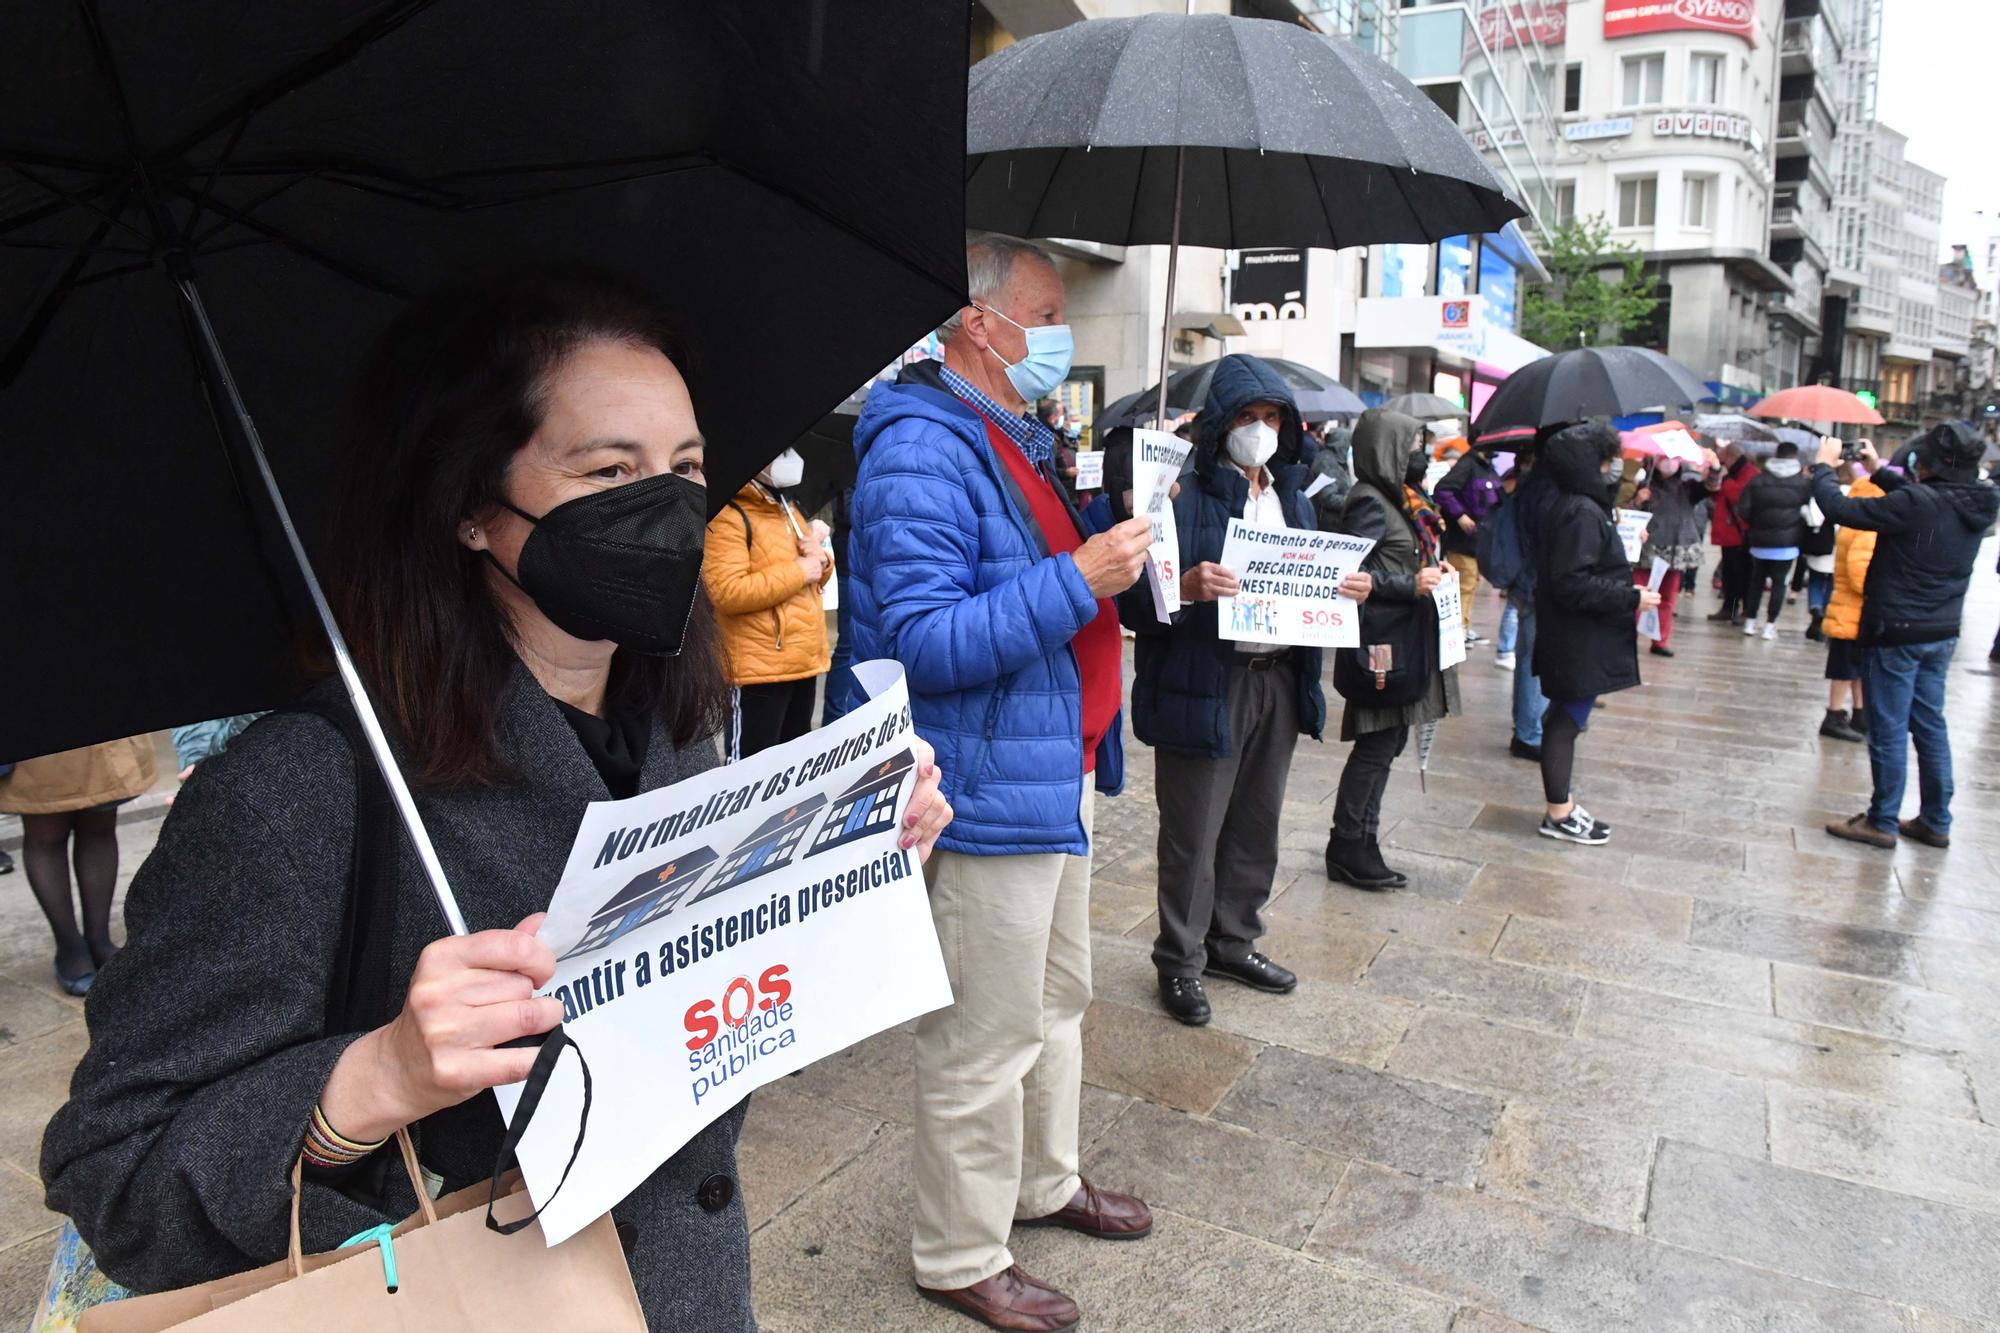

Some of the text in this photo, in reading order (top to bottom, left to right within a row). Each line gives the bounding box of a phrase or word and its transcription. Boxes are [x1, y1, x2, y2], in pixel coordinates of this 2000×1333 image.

[1233, 524, 1371, 553] Incremento de persoal
[1246, 560, 1339, 580] PRECARIEDADE
[1302, 610, 1343, 626] SOS
[593, 779, 763, 869] Normalizar
[761, 765, 795, 802] os
[795, 726, 876, 787] centros
[875, 712, 898, 749] de
[635, 951, 652, 988] a
[659, 893, 791, 977] asistencia
[798, 849, 912, 923] presencial
[684, 964, 792, 1051] SOS
[689, 1002, 793, 1072] sanidade
[692, 1028, 796, 1106] pública
